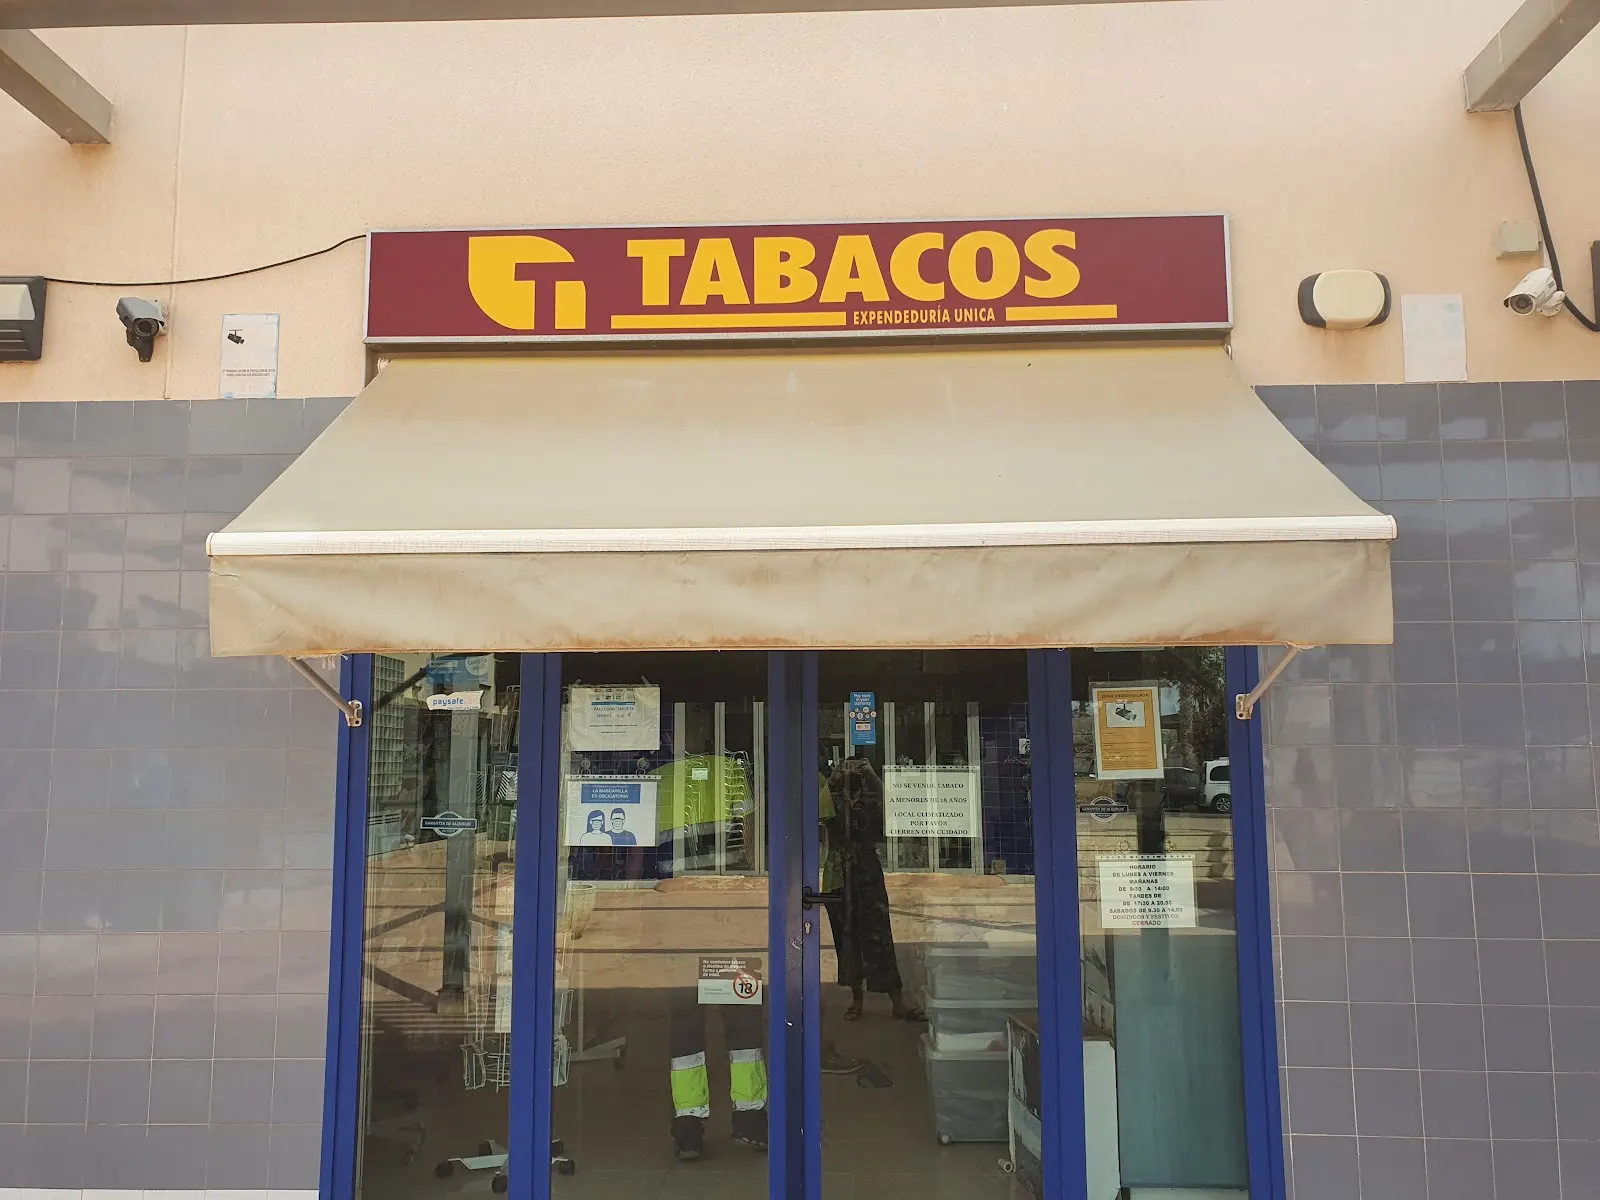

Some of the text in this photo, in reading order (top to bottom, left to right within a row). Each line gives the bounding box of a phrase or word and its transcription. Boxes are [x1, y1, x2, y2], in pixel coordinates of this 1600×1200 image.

[627, 228, 1081, 305] TABACOS
[853, 305, 996, 325] EXPENDEDURÍA UNICA
[738, 982, 753, 994] 18
